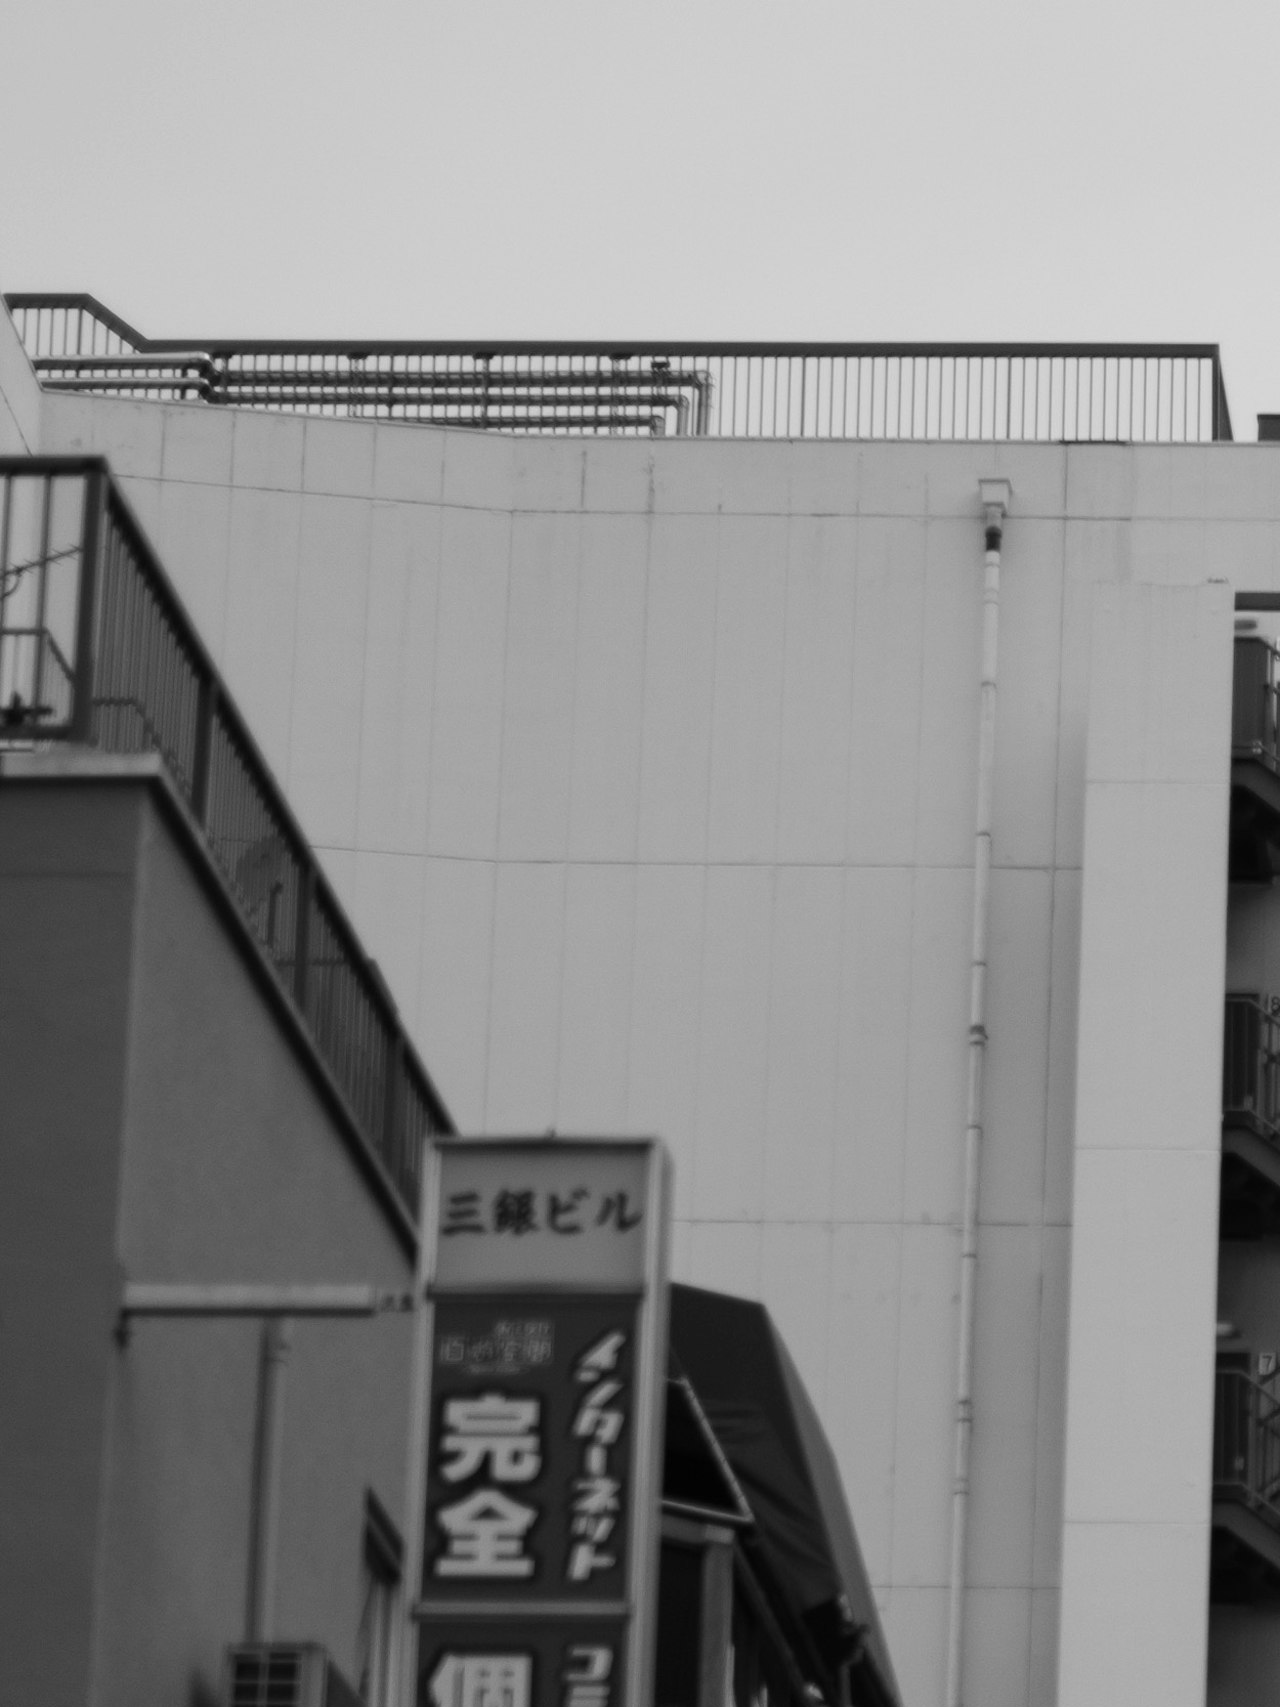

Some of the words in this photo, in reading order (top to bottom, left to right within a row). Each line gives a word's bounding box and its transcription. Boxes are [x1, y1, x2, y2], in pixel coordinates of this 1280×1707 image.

[442, 1187, 643, 1237] 三銀ビル
[1262, 1355, 1273, 1372] 7
[434, 1394, 542, 1577] 完全
[566, 1328, 626, 1581] インターネット
